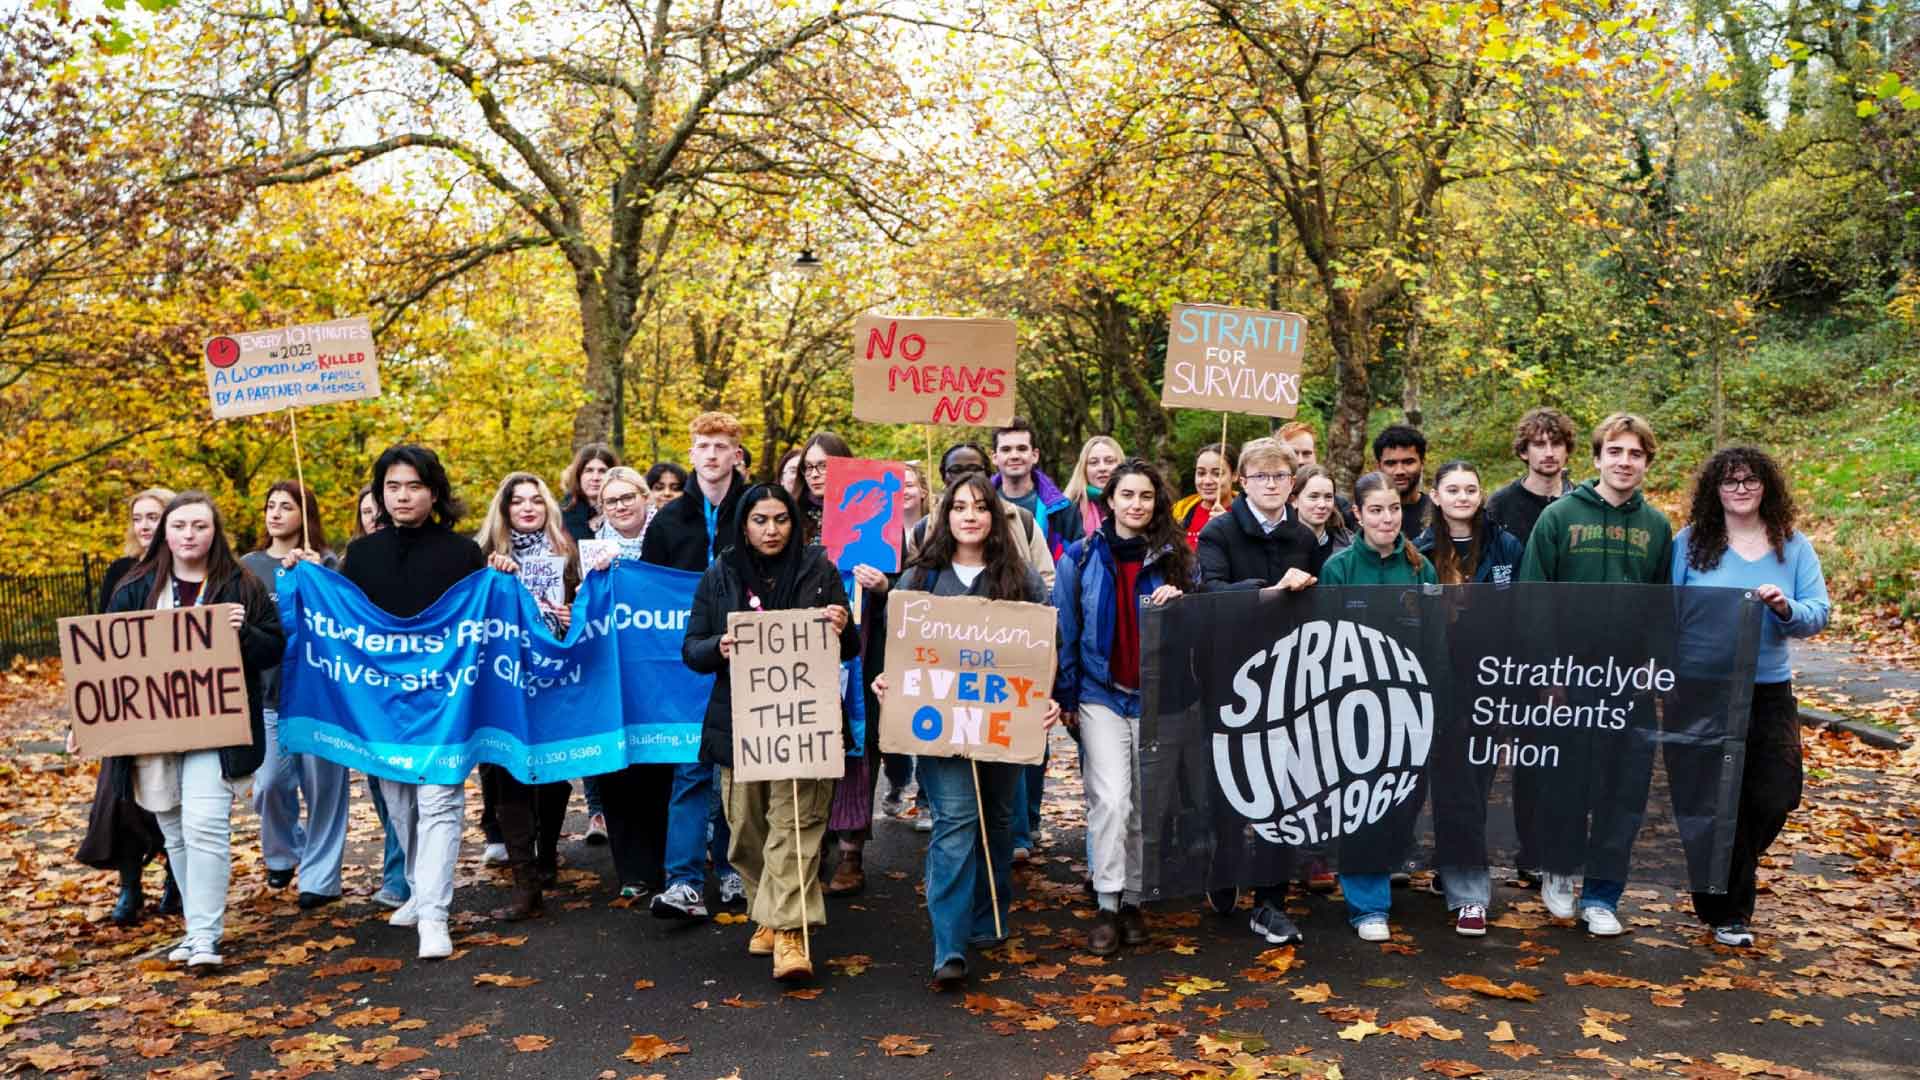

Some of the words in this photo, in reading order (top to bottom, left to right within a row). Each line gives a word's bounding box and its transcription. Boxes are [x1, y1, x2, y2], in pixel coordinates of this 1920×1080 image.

[241, 334, 281, 350] EVERY
[287, 327, 305, 344] 10
[308, 325, 369, 342] MINUTES
[866, 321, 926, 361] NO
[1178, 308, 1299, 352] STRATH
[214, 370, 227, 386] A
[317, 352, 365, 369] KILLED
[281, 343, 312, 359] 2023
[1206, 347, 1246, 365] FOR
[216, 391, 231, 406] BY
[235, 389, 245, 401] A
[248, 383, 302, 401] PARTNER
[305, 383, 320, 393] OR
[321, 382, 366, 394] MEMBER
[888, 365, 1006, 397] MEANS
[1171, 361, 1301, 405] SURVIVORS
[932, 396, 988, 424] NO
[69, 616, 154, 664] NOT
[173, 610, 212, 652] IN
[733, 618, 833, 655] FIGHT
[896, 600, 1049, 648] Feminism
[915, 647, 940, 664] IS
[960, 649, 996, 668] FOR
[1220, 620, 1428, 728] STRATH
[750, 662, 815, 692] FOR
[902, 668, 1045, 708] EVERY-
[1477, 656, 1675, 696] Strathclyde
[75, 675, 142, 726] OUR
[146, 667, 242, 720] NAME
[750, 700, 817, 728] THE
[1472, 696, 1634, 730] Students'
[912, 705, 1011, 748] ONE
[741, 730, 833, 766] NIGHT
[1213, 687, 1434, 820] UNION
[1468, 736, 1560, 767] Union
